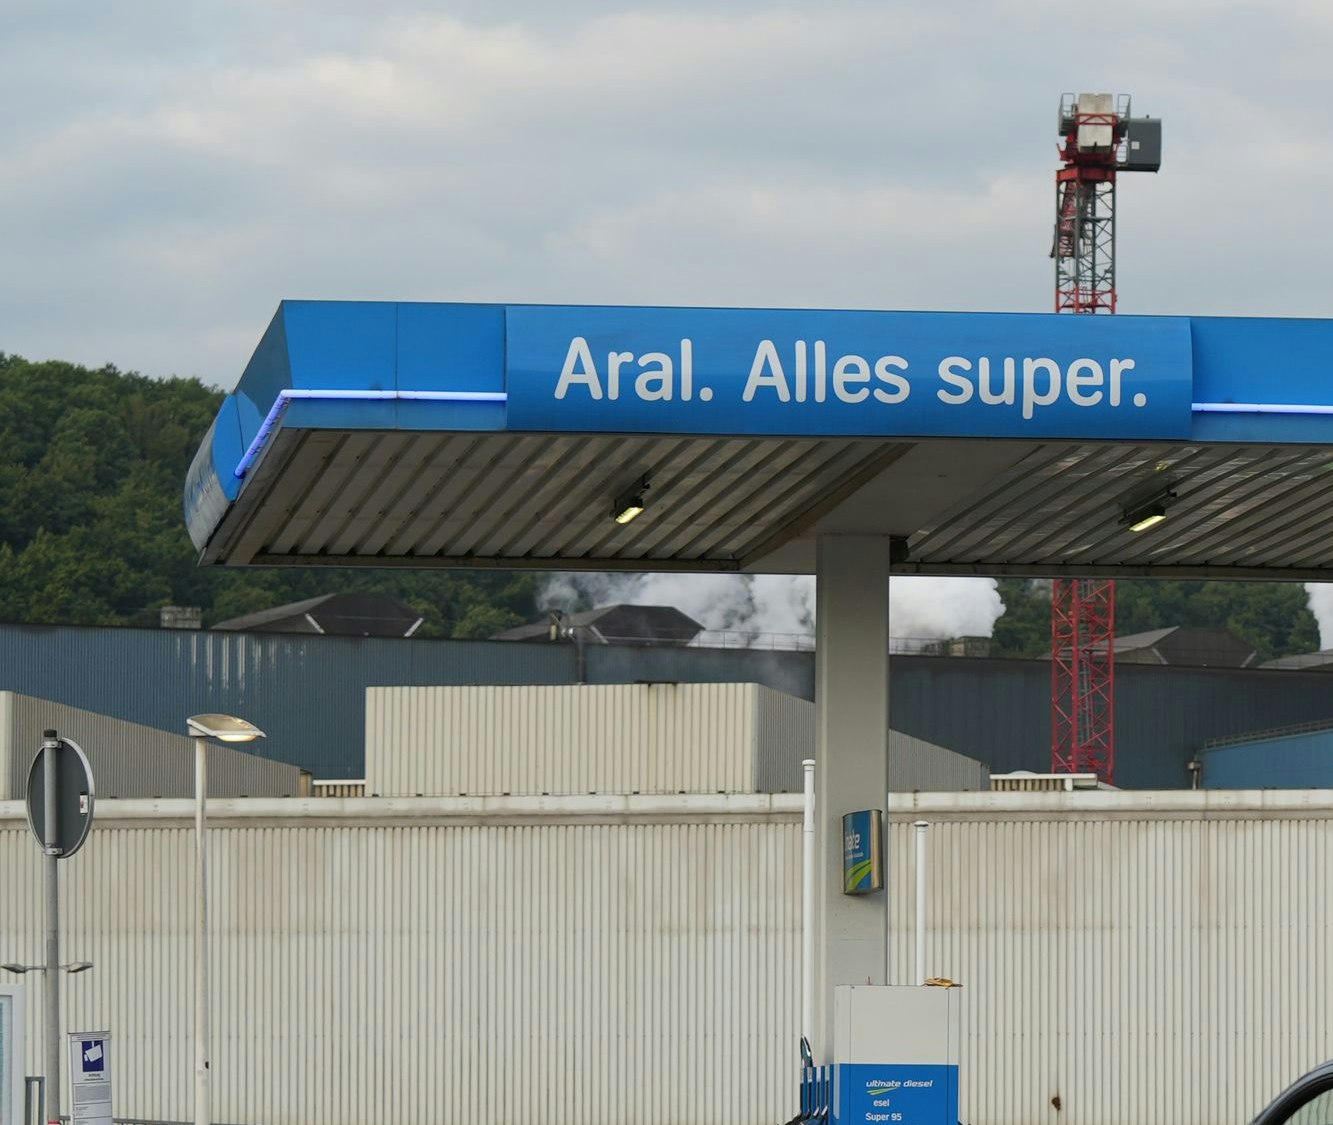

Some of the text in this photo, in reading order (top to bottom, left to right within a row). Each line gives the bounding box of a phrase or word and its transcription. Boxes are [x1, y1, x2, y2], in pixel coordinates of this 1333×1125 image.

[554, 336, 1148, 421] Aral. Alles super.
[866, 1080, 934, 1088] ultimate diesel
[865, 1112, 903, 1122] Super 95
